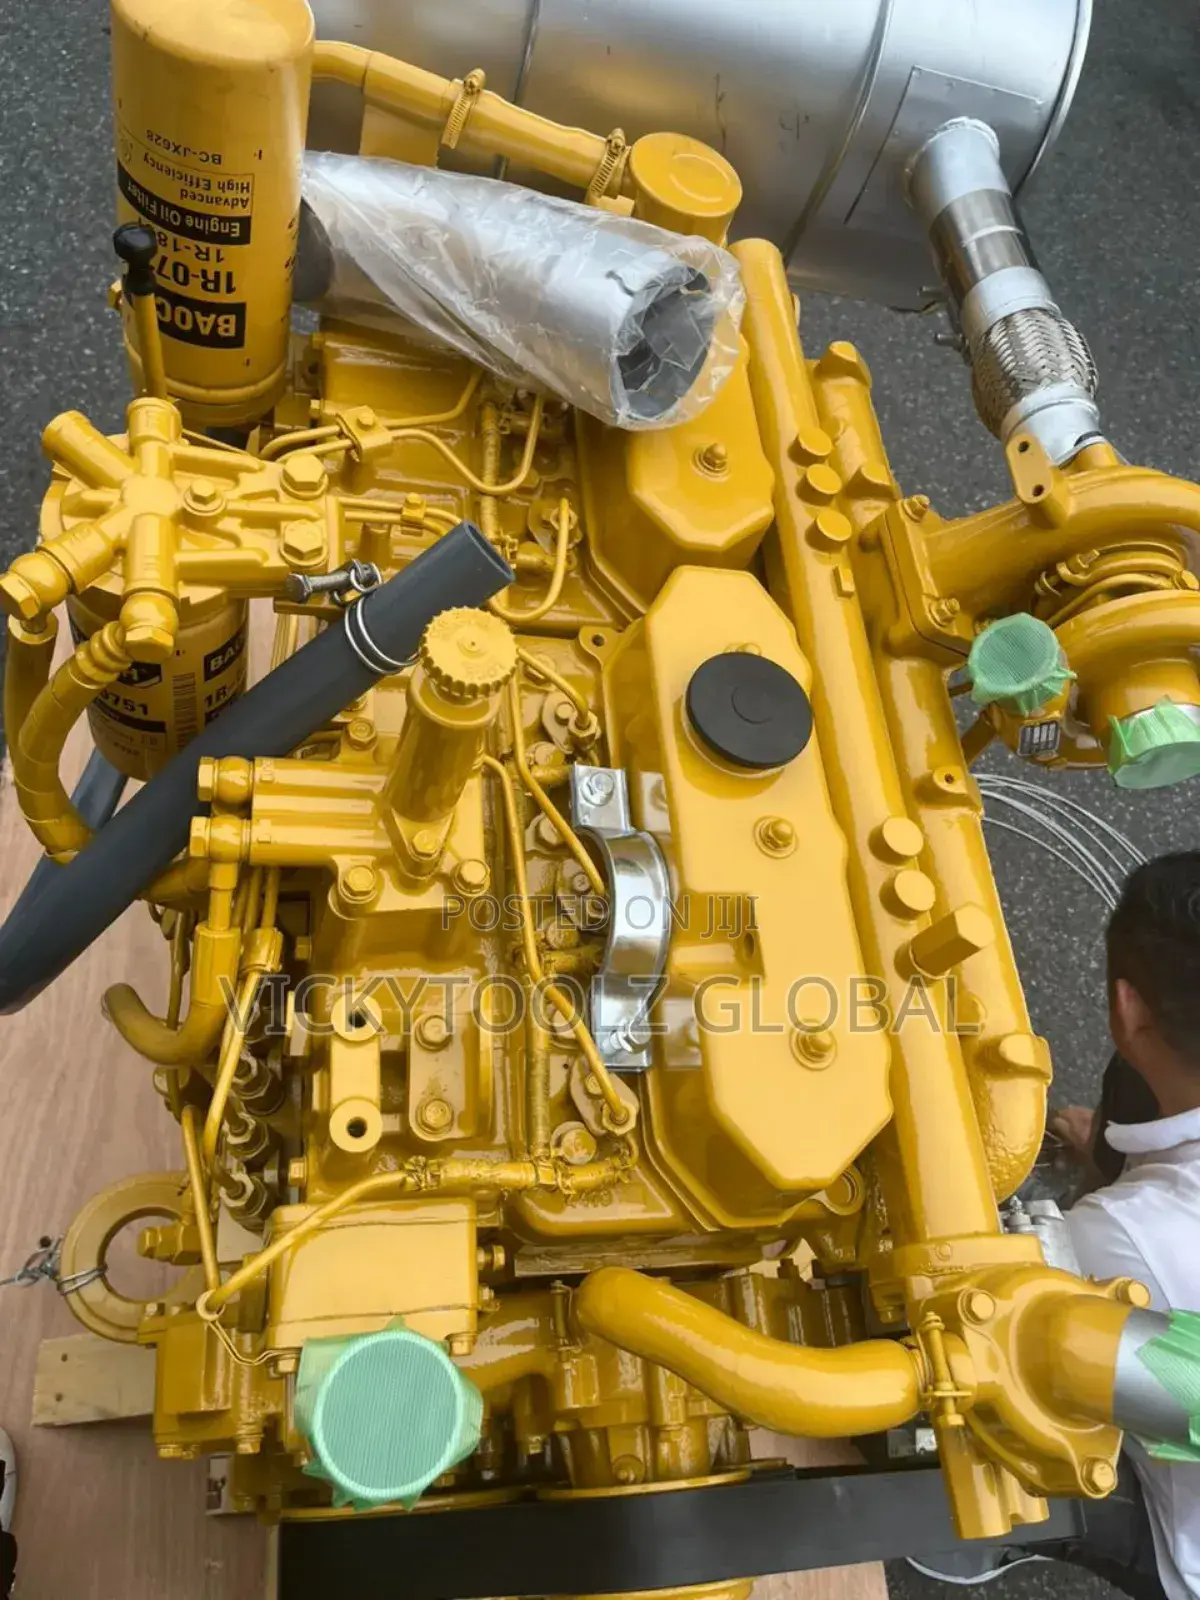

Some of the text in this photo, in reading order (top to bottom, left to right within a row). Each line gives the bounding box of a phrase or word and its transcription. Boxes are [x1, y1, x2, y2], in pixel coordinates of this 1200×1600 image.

[146, 129, 222, 165] BC-JX628
[143, 152, 250, 193] High Efficiency
[127, 180, 241, 237] Engine Oil Filter
[180, 188, 249, 209] Advanced
